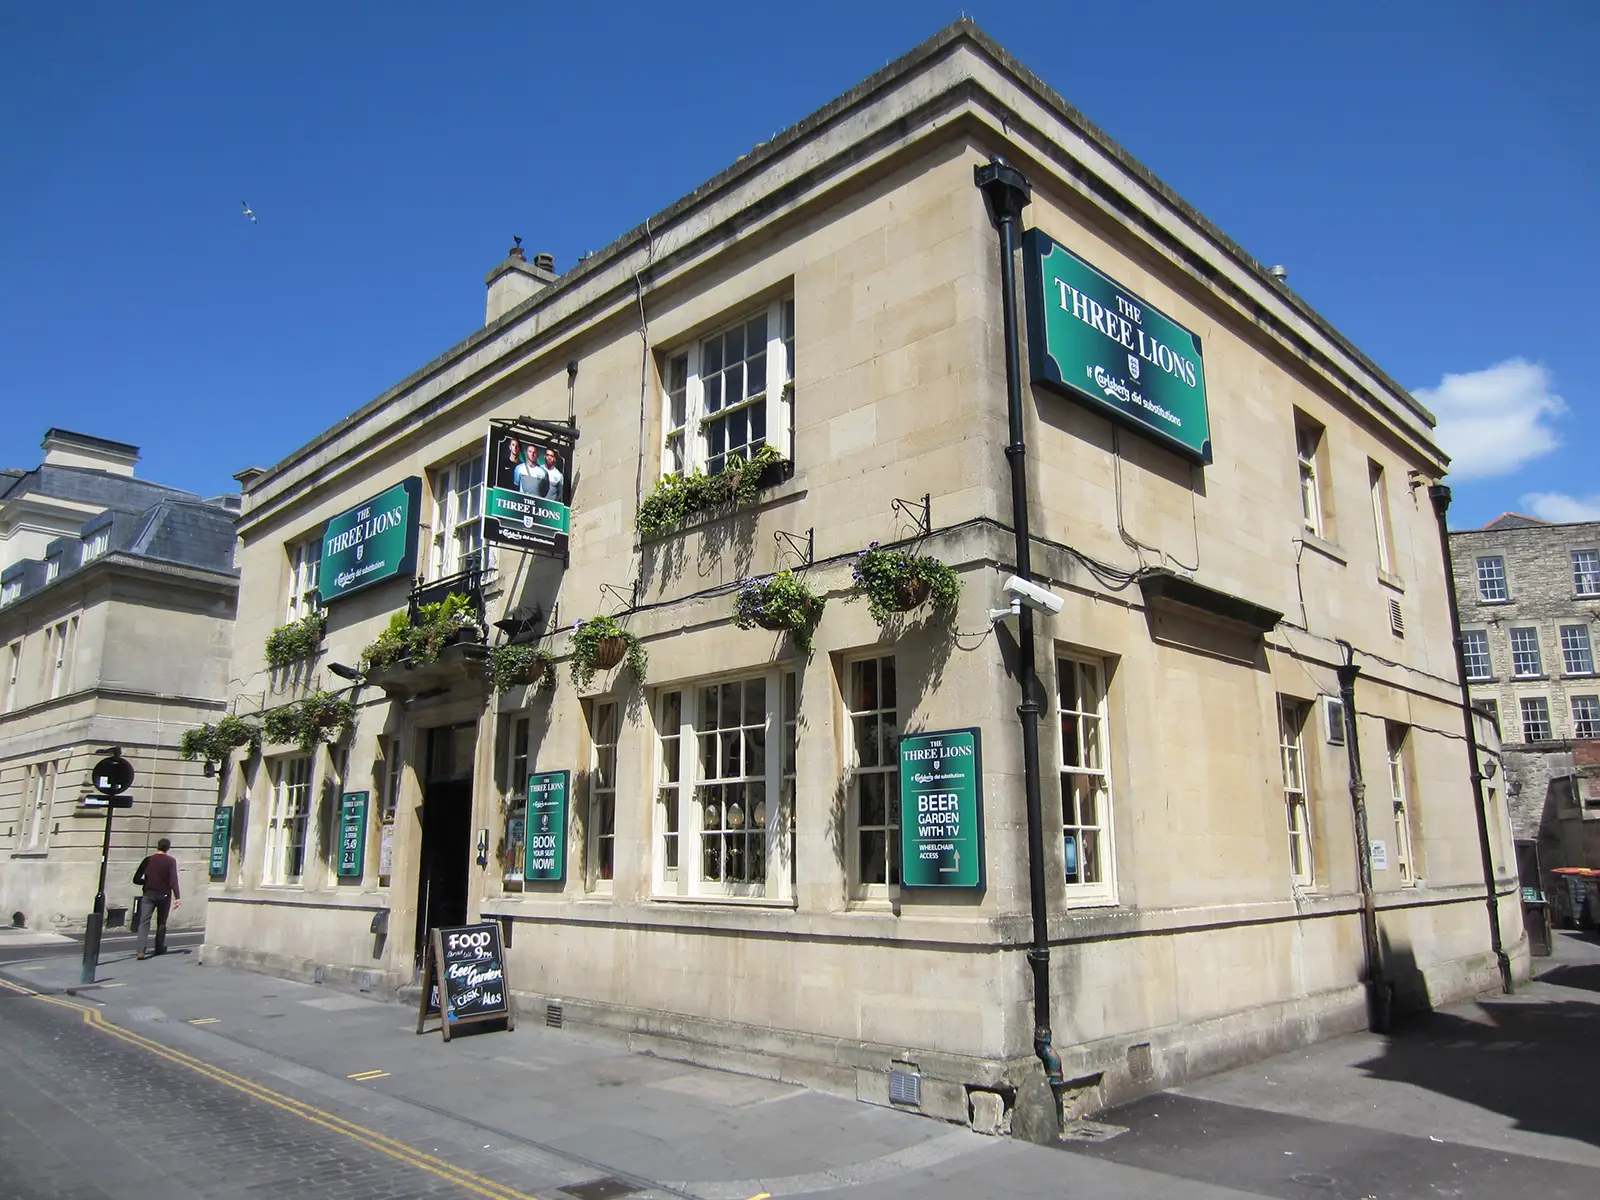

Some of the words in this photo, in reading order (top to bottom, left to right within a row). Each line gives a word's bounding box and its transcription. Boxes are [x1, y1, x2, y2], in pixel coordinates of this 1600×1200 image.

[1115, 295, 1142, 325] THE
[1054, 277, 1135, 351] THREE
[1138, 327, 1196, 388] LIONS
[1086, 365, 1093, 378] If
[1094, 365, 1130, 402] Carlsberg
[1131, 391, 1142, 405] did
[1142, 399, 1182, 427] substitutions
[496, 498, 531, 514] THREE
[532, 506, 561, 520] LIONS
[524, 498, 536, 506] THE
[357, 507, 371, 523] THE
[327, 523, 364, 557] THREE
[364, 505, 402, 540] LIONS
[930, 740, 943, 748] THE
[903, 748, 938, 761] THREE
[940, 745, 972, 759] LIONS
[530, 784, 547, 793] THREE
[547, 782, 564, 791] LIONS
[918, 793, 959, 812] BEER
[918, 812, 960, 825] GARDEN
[918, 826, 944, 837] WITH
[946, 825, 960, 836] TV
[533, 836, 556, 848] BOOK
[919, 843, 954, 851] WHEELCHAIR
[919, 852, 939, 860] ACCESS
[532, 859, 555, 870] NOW!!
[448, 932, 491, 949] FOOD
[449, 963, 476, 979] Beer
[467, 968, 503, 987] Garden
[457, 989, 480, 1006] CASK
[482, 992, 501, 1005] Ales
